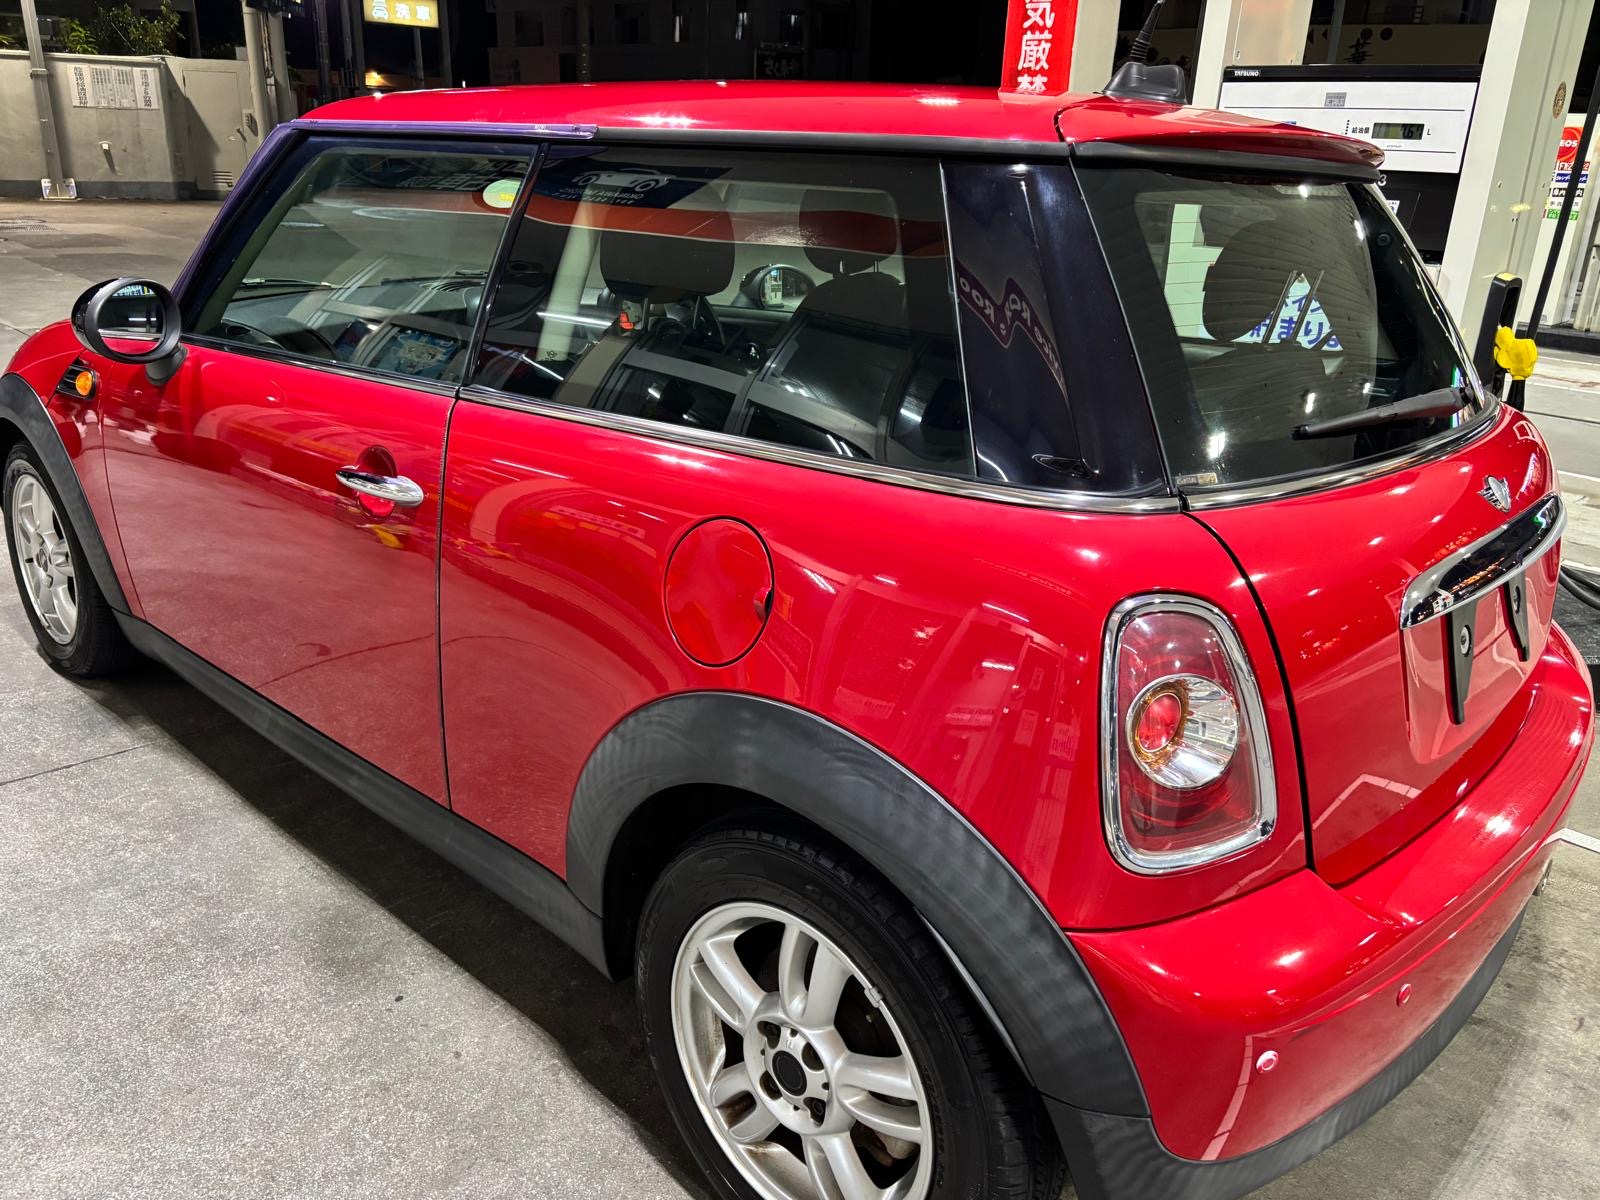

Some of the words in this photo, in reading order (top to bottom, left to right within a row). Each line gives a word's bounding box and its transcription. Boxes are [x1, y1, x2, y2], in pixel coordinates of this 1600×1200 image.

[1351, 126, 1370, 134] 給油量
[1559, 139, 1578, 147] EOS
[1377, 174, 1387, 187] 3
